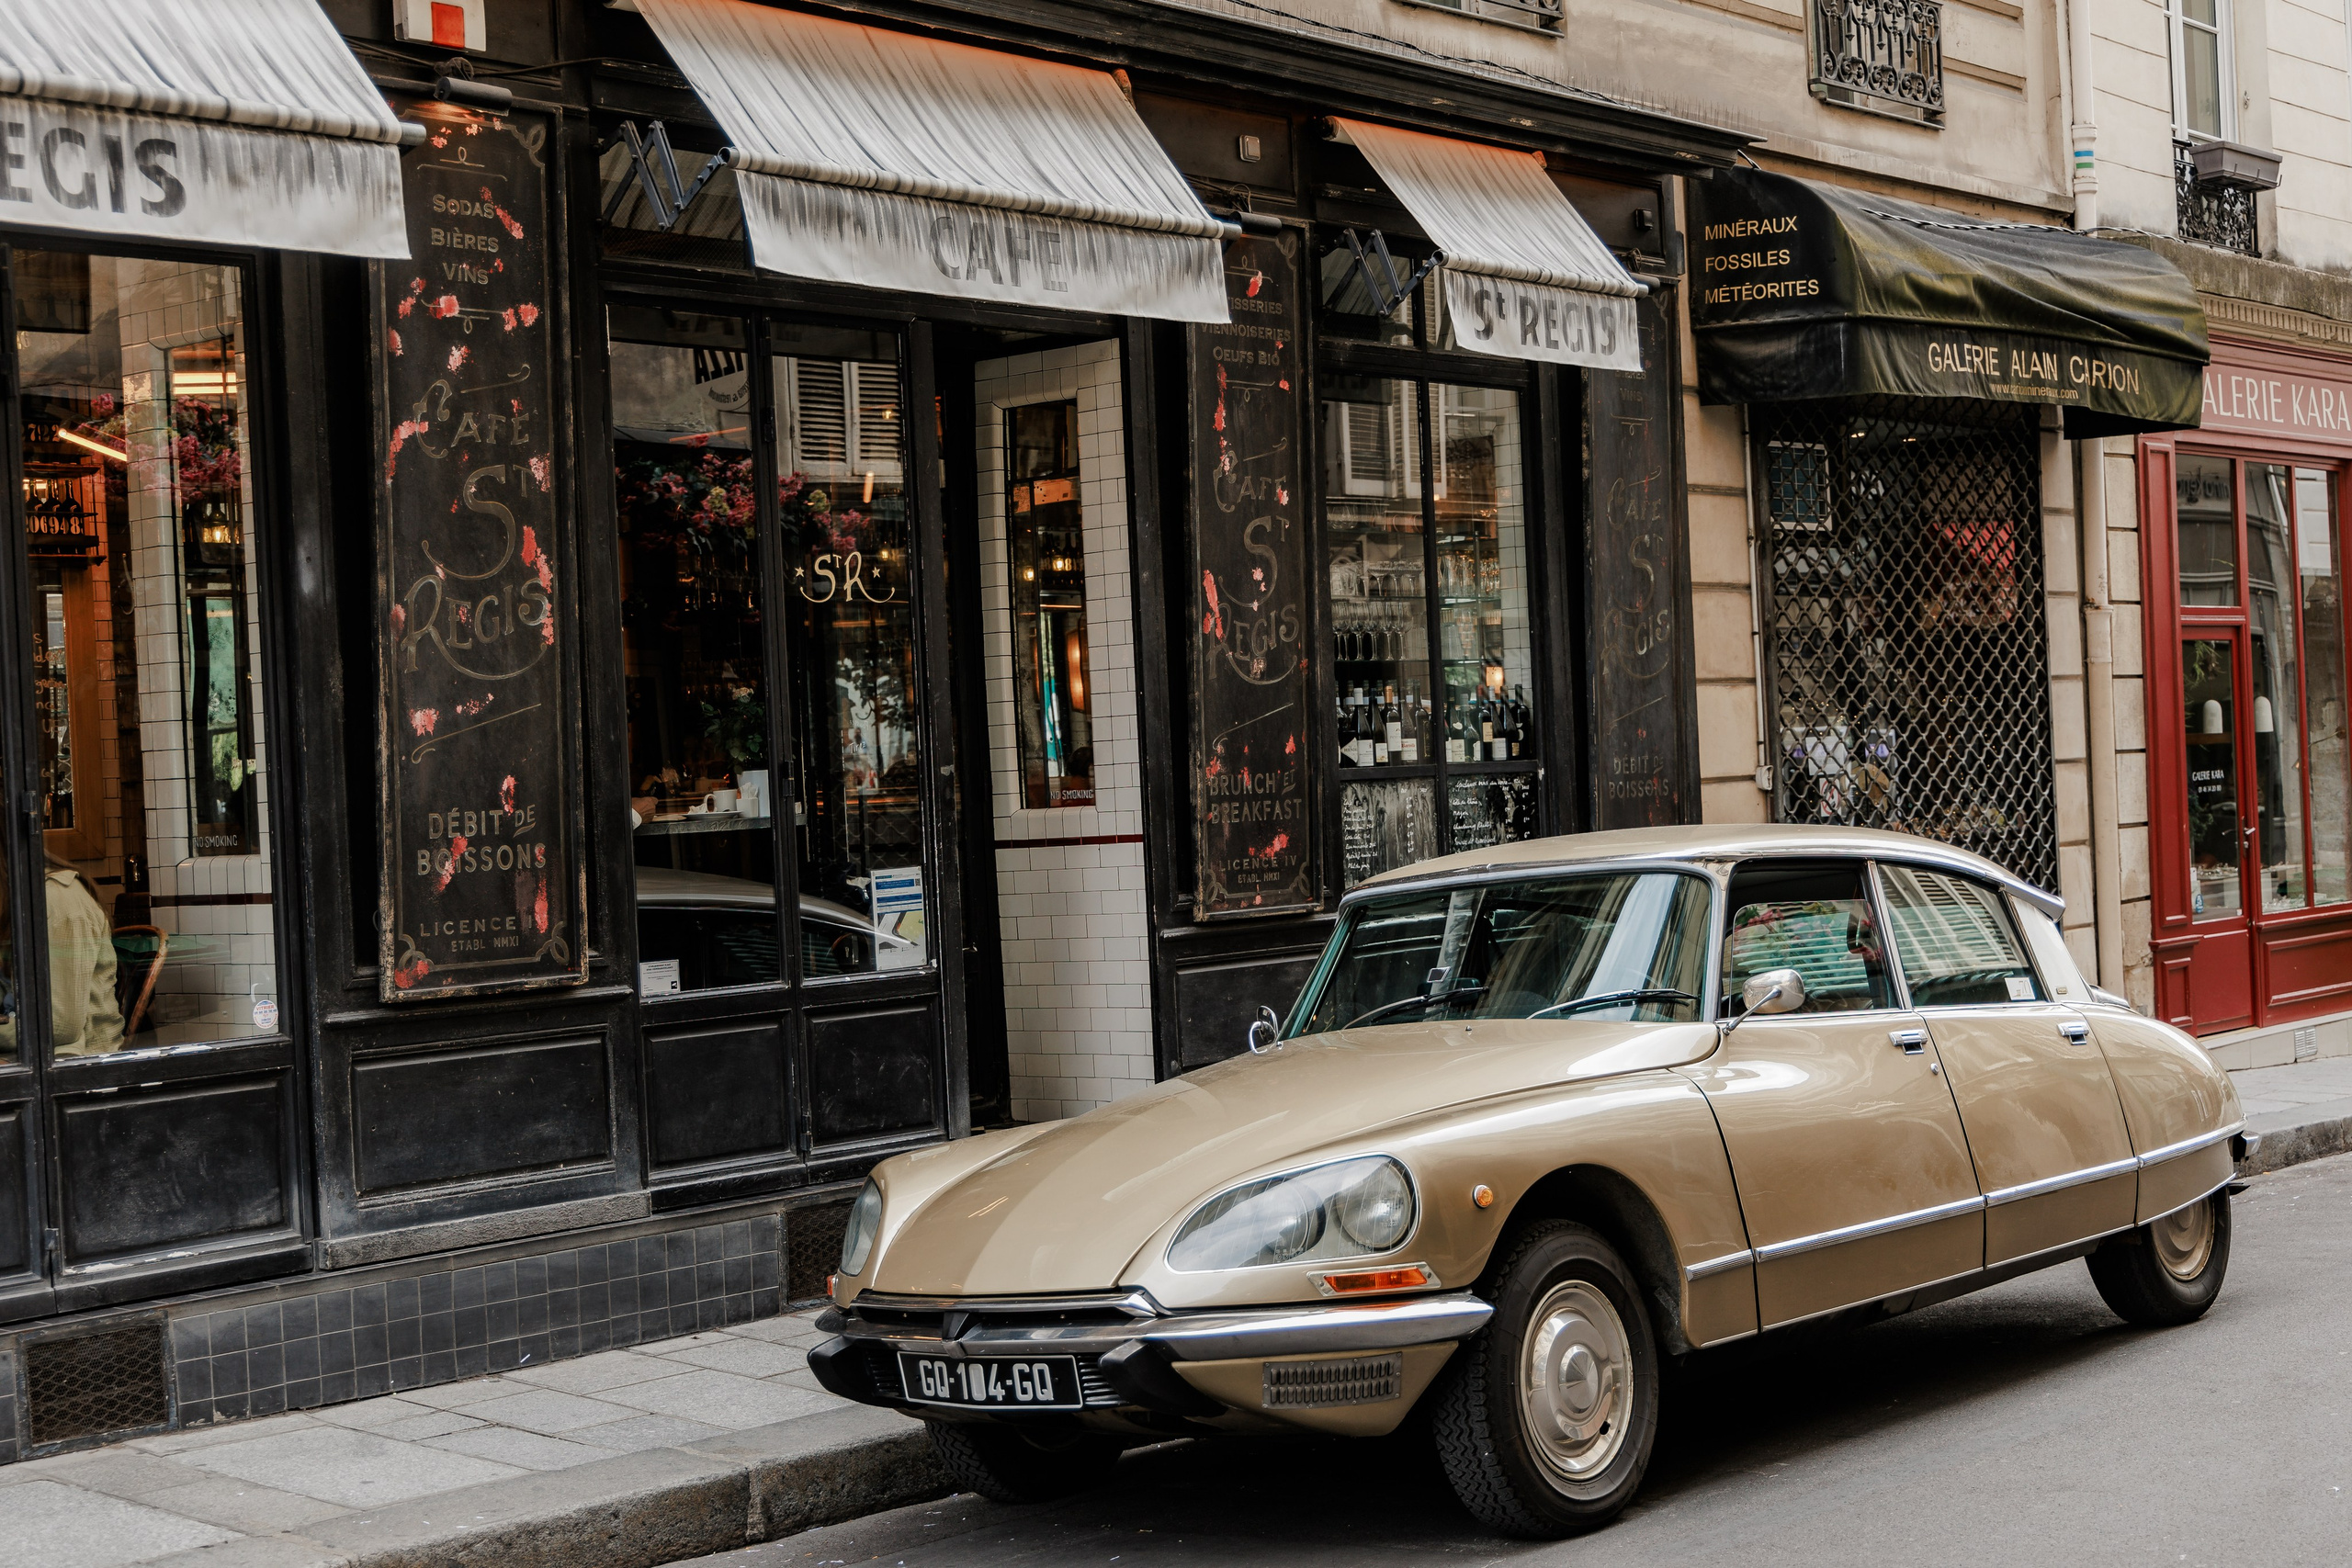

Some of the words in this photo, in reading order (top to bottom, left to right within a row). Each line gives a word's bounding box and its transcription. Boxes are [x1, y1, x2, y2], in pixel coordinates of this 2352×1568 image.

[432, 194, 495, 220] SODAS
[430, 227, 500, 253] BIÈRES
[1705, 215, 1798, 241] MINÉRAUX
[442, 262, 489, 285] VINS
[1705, 249, 1791, 273] FOSSILES
[1704, 278, 1820, 305] MÉTÉORITES
[1519, 296, 1617, 356] REGIS
[1258, 350, 1280, 367] BIO
[1928, 342, 2001, 377] GALERIE
[2010, 349, 2059, 382] ALAIN
[2069, 355, 2140, 395] CARION
[2291, 384, 2352, 432] KARA
[401, 574, 548, 680] REGIS
[1050, 790, 1060, 800] NO
[1061, 789, 1094, 800] SMOKING
[1209, 773, 1276, 795] BRUNCH
[1609, 779, 1669, 799] BOISSONS
[428, 807, 503, 840] DÉBIT
[514, 804, 536, 828] DE
[1211, 798, 1303, 824] BREAKFAST
[194, 836, 204, 848] NO
[204, 834, 238, 848] SMOKING
[1218, 856, 1278, 872] LICENCE
[1285, 854, 1297, 866] IV
[420, 916, 516, 937] LICENCE
